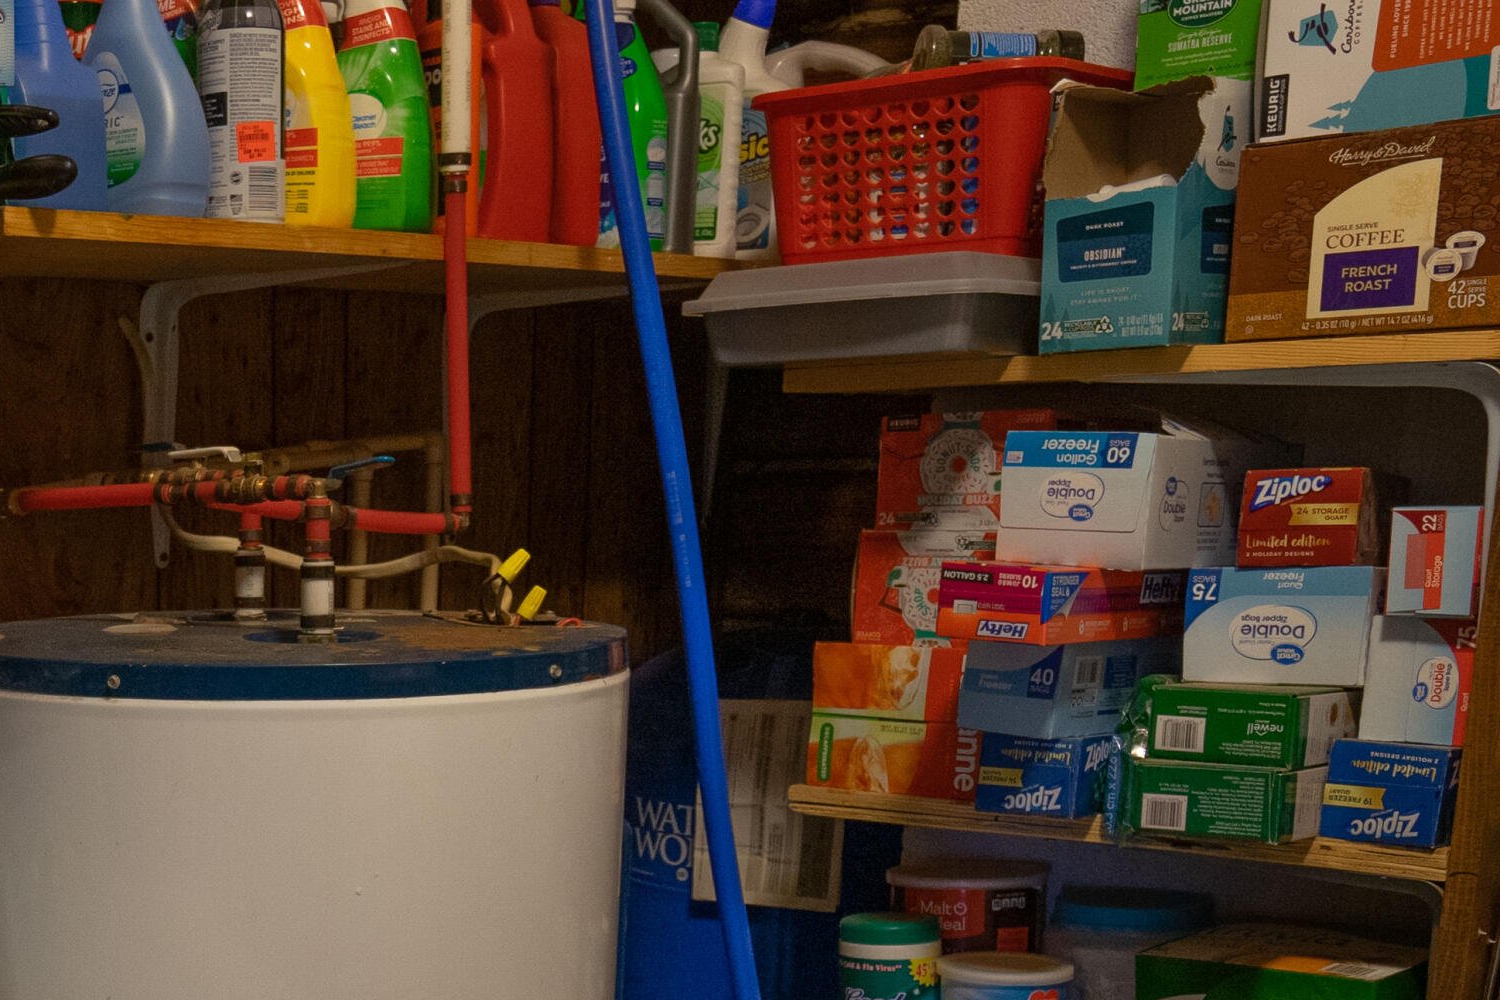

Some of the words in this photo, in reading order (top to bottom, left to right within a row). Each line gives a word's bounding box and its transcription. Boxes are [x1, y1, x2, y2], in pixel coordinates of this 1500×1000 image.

[1173, 0, 1232, 17] MOUNTAIN
[1168, 38, 1200, 53] SUMATRA
[1201, 33, 1234, 48] RESERVE
[1266, 79, 1281, 133] KEURIG
[1327, 224, 1353, 232] SINGLE
[1355, 221, 1379, 230] SERVE
[1325, 228, 1405, 249] COFFEE
[1341, 263, 1398, 278] FRENCH
[1344, 278, 1392, 293] ROAST
[1447, 280, 1466, 295] 42
[1467, 285, 1487, 294] SERVE
[1447, 293, 1487, 309] CUPS
[1263, 313, 1282, 322] ROAST
[1041, 321, 1063, 341] 24
[1041, 438, 1100, 454] Freezer
[1108, 438, 1131, 448] BAGS
[1056, 452, 1098, 466] Gallon
[1106, 446, 1131, 465] 60
[1047, 478, 1073, 488] Zipper
[1253, 475, 1326, 505] Ziploc
[965, 494, 995, 506] BUZZ
[1046, 486, 1096, 501] Double
[1296, 507, 1309, 516] 24
[1312, 506, 1349, 515] STORAGE
[1421, 514, 1437, 531] 22
[1245, 533, 1288, 549] Limited
[1290, 533, 1332, 548] edition
[943, 570, 972, 582] GALLON
[973, 573, 989, 582] 2.5
[1192, 574, 1217, 583] BAGS
[1263, 571, 1305, 581] Freezer
[1425, 567, 1433, 588] Quart
[1431, 554, 1443, 588] Storage
[1021, 574, 1039, 589] 10
[1277, 581, 1304, 590] Quart
[1051, 586, 1065, 597] SEAL
[1192, 582, 1217, 601] 75
[1241, 614, 1261, 623] Bags
[1263, 614, 1289, 623] Zipper
[978, 620, 1028, 638] Hefty
[1240, 623, 1306, 639] Double
[1030, 667, 1055, 686] 40
[1430, 662, 1446, 704] Double
[1460, 692, 1470, 713] Quart
[1247, 722, 1285, 736] newell
[1001, 747, 1031, 761] edition
[1032, 751, 1072, 767] Limited
[1370, 751, 1400, 760] DESIGNS
[1404, 754, 1433, 764] HOLIDAY
[1350, 758, 1392, 776] edition
[1393, 763, 1438, 783] Limited
[1004, 785, 1063, 813] Ziploc
[1327, 793, 1363, 806] FREEZER
[635, 797, 696, 835] WAT
[1350, 810, 1421, 839] Ziploc
[635, 828, 693, 867] WO
[920, 900, 951, 915] Malt
[940, 917, 967, 932] eal
